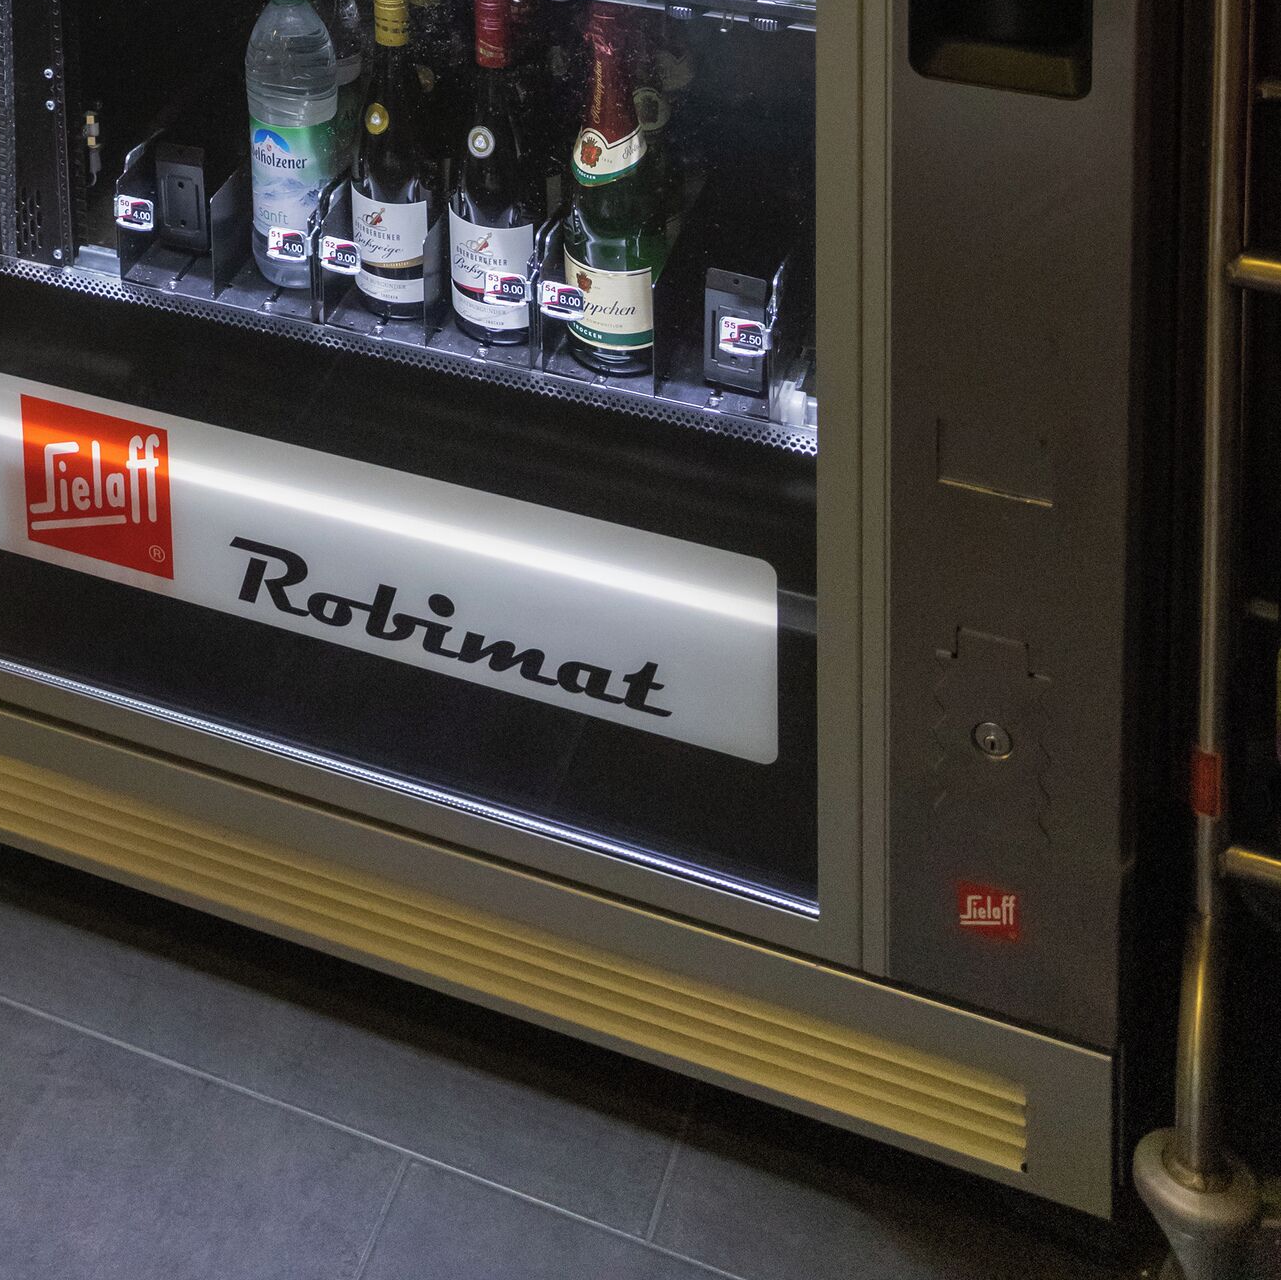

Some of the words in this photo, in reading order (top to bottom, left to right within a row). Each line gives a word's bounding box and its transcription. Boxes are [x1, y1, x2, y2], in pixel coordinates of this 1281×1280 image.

[133, 210, 150, 220] 4.00
[284, 242, 302, 253] 4.00
[337, 252, 355, 263] 9.00
[502, 284, 523, 294] 9.00
[560, 295, 580, 306] 8.00
[573, 322, 603, 341] TROCKEN
[740, 333, 761, 345] 2.50
[30, 433, 160, 528] Sielaff
[230, 535, 672, 717] Robimat
[960, 893, 1016, 926] Sielaff
